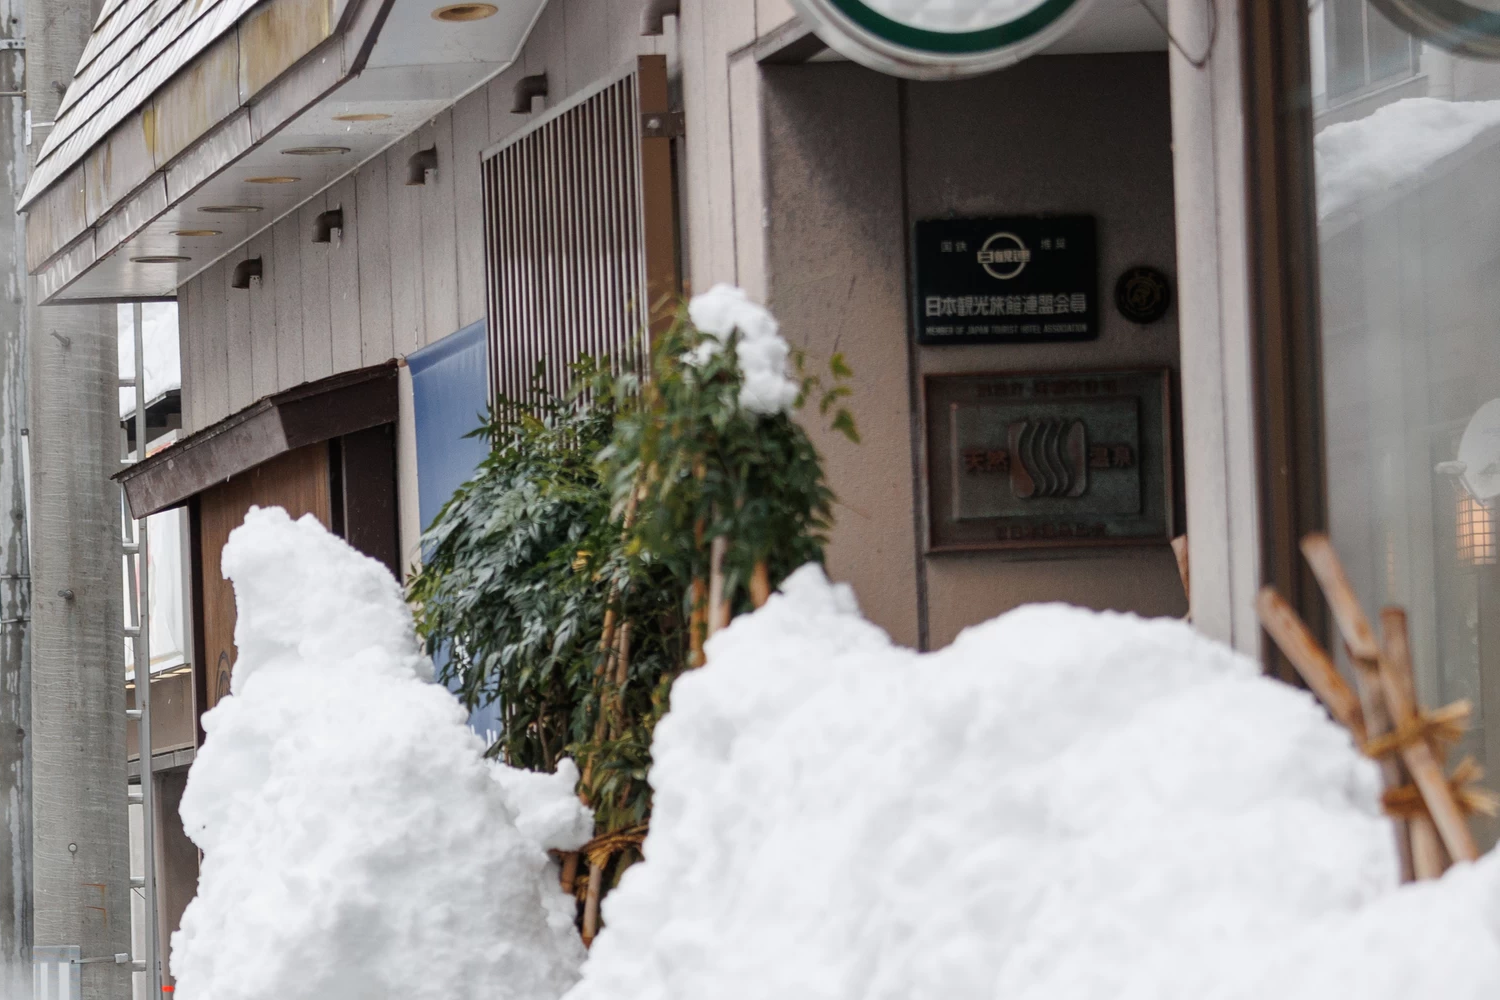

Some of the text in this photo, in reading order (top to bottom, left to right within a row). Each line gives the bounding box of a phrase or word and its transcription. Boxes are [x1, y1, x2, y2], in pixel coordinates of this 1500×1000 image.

[925, 293, 1088, 317] 日本観光旅館連盟会員
[1043, 322, 1088, 334] ASSOCIATION
